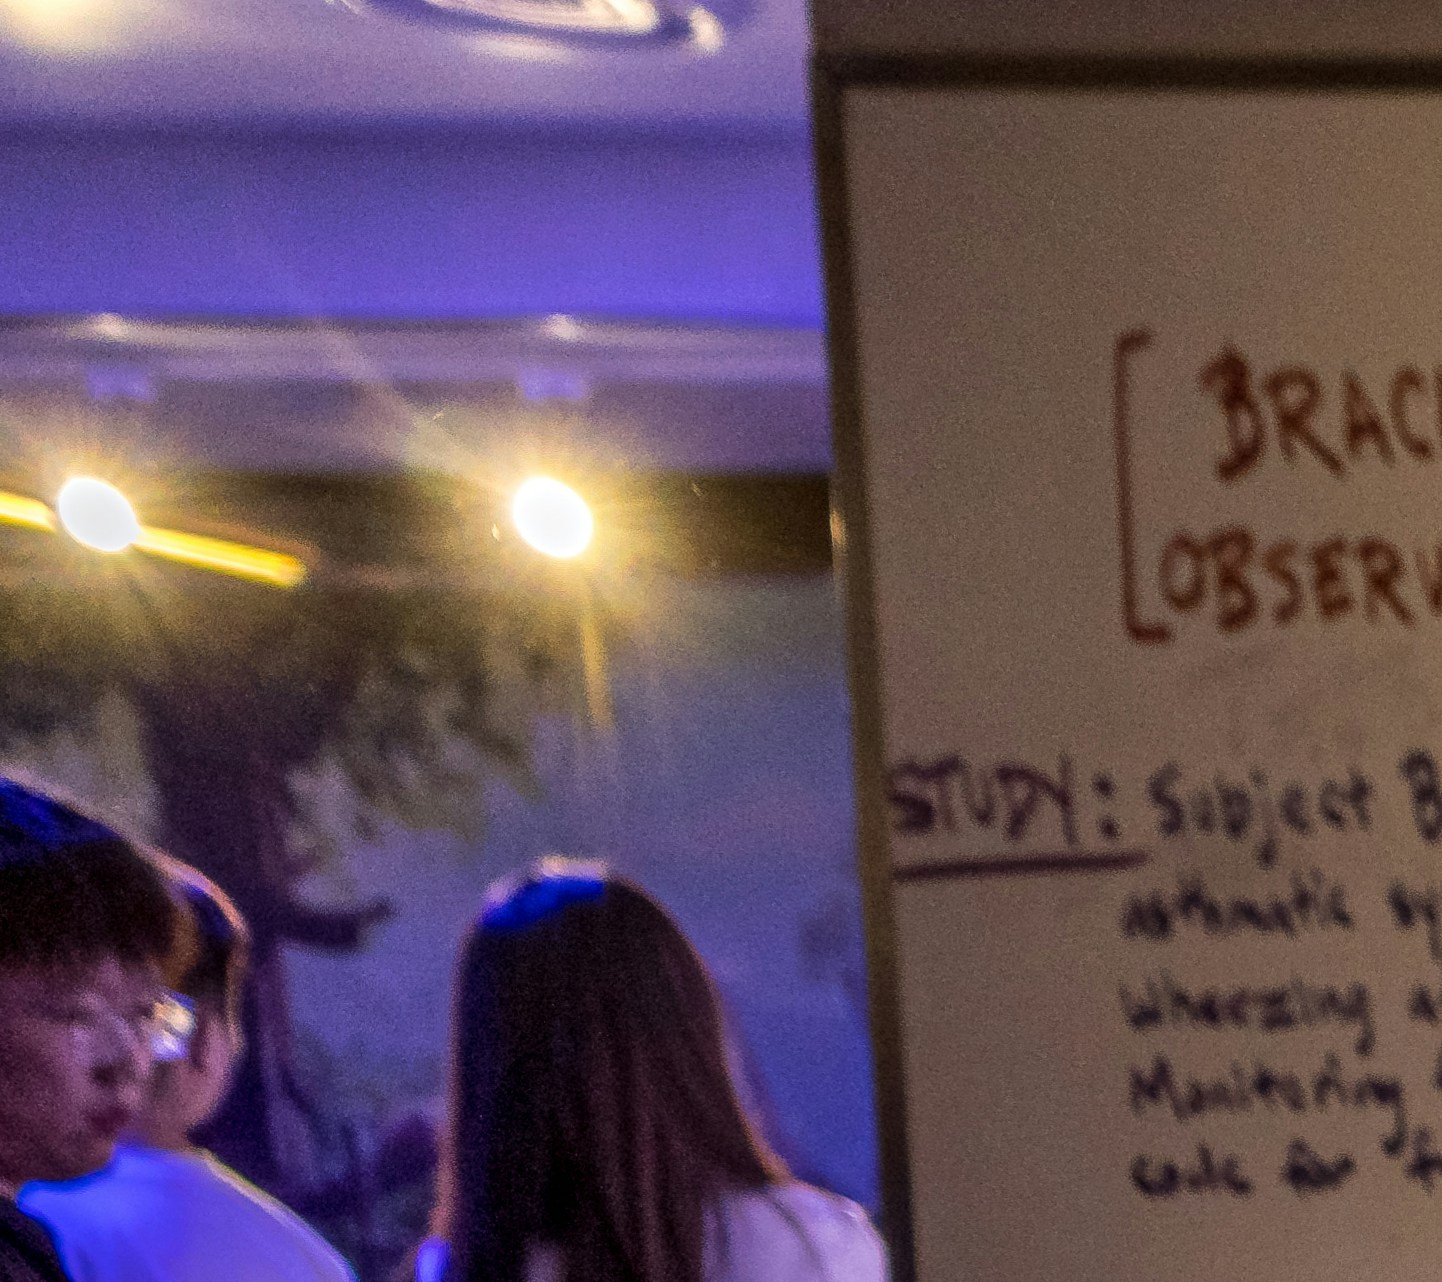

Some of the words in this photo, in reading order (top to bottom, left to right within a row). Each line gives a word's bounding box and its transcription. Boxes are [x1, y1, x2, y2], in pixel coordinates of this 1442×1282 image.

[893, 750, 1120, 846] STUDY:
[1147, 758, 1375, 870] Subject
[1127, 1050, 1411, 1160] Monitoring
[1281, 1136, 1358, 1196] for
